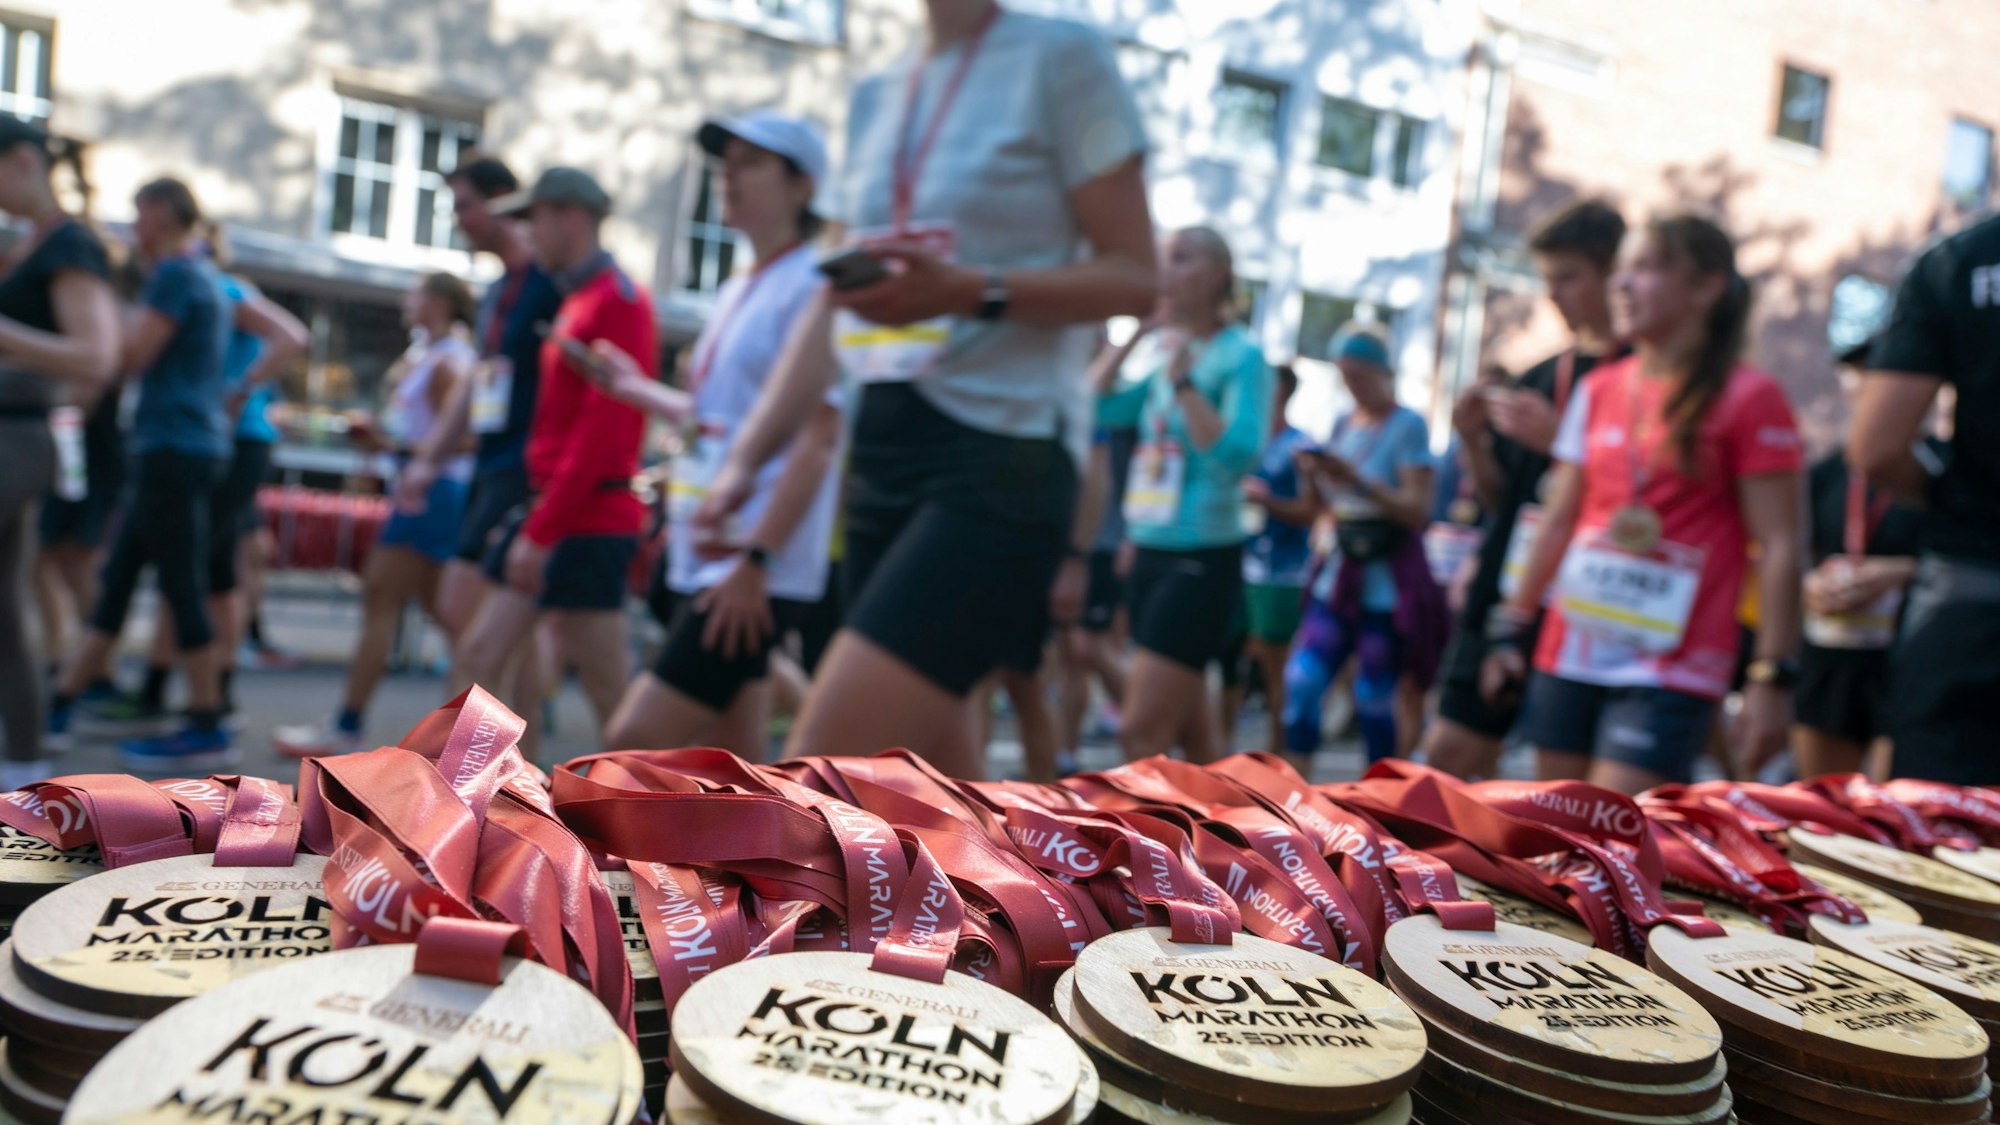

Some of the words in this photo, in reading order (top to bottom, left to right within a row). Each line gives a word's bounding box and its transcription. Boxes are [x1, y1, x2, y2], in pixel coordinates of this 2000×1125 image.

[1184, 957, 1297, 972] GENERALI
[1437, 959, 1641, 991] KÖLN
[1712, 959, 1884, 999] KÖLN
[847, 986, 980, 1021] GENERALI
[1129, 972, 1357, 1010] KÖLN
[1486, 993, 1677, 1012] MARATHON
[1779, 988, 1922, 1016] MARATHON
[368, 1000, 534, 1046] GENERALI
[749, 986, 1011, 1067] KÖLN
[1155, 1008, 1379, 1031] MARATHON
[1577, 1014, 1681, 1029] EDITION
[1197, 1031, 1242, 1046] 25.
[1243, 1032, 1375, 1049] EDITION
[201, 1017, 545, 1121] KÖLN
[735, 1025, 1002, 1091] MARATHON
